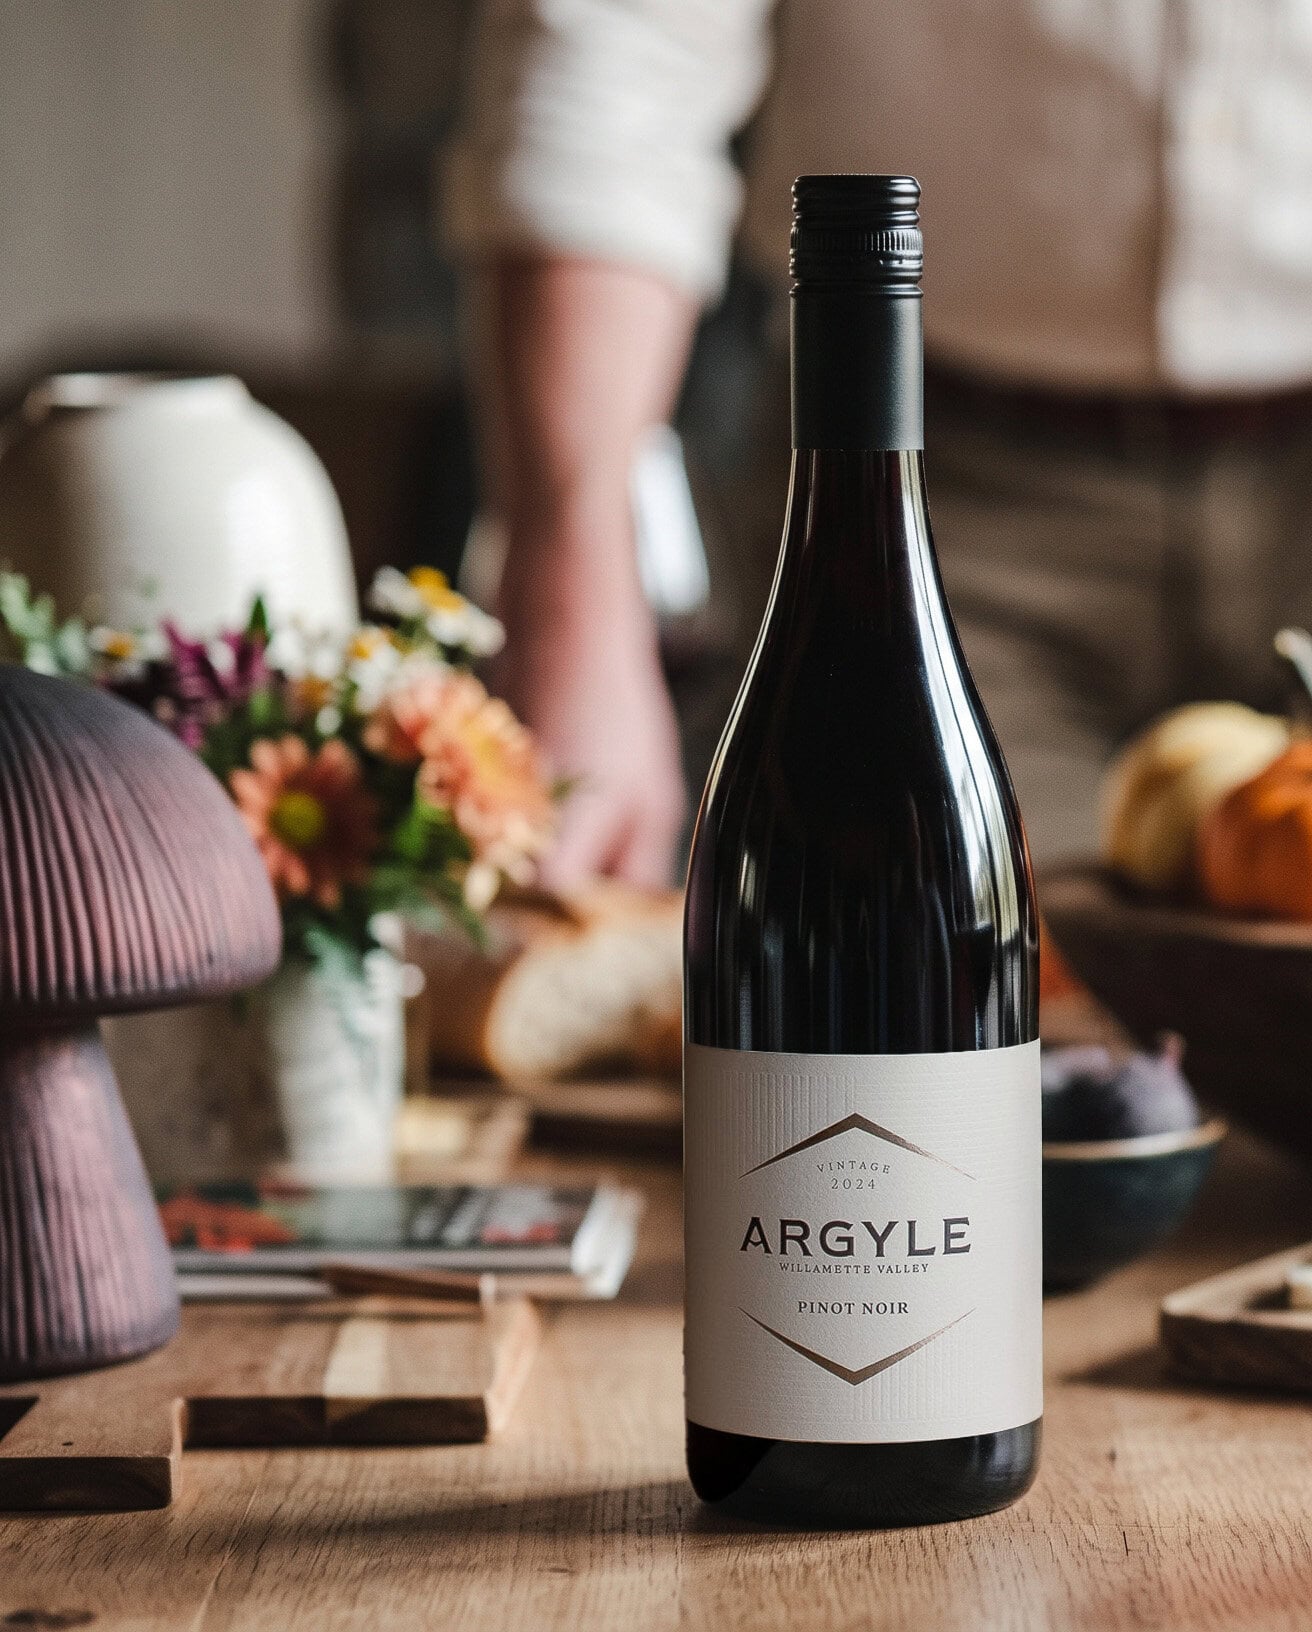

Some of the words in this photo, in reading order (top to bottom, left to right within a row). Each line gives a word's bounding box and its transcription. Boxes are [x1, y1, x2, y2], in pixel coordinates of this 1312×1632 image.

[816, 1159, 891, 1174] VINTAGE
[830, 1177, 876, 1190] 2024
[739, 1216, 972, 1258] ARGYLE
[778, 1262, 871, 1274] WILLAMETTE
[877, 1262, 930, 1274] VALLEY
[798, 1300, 856, 1315] PINOT
[861, 1301, 909, 1315] NOIR
